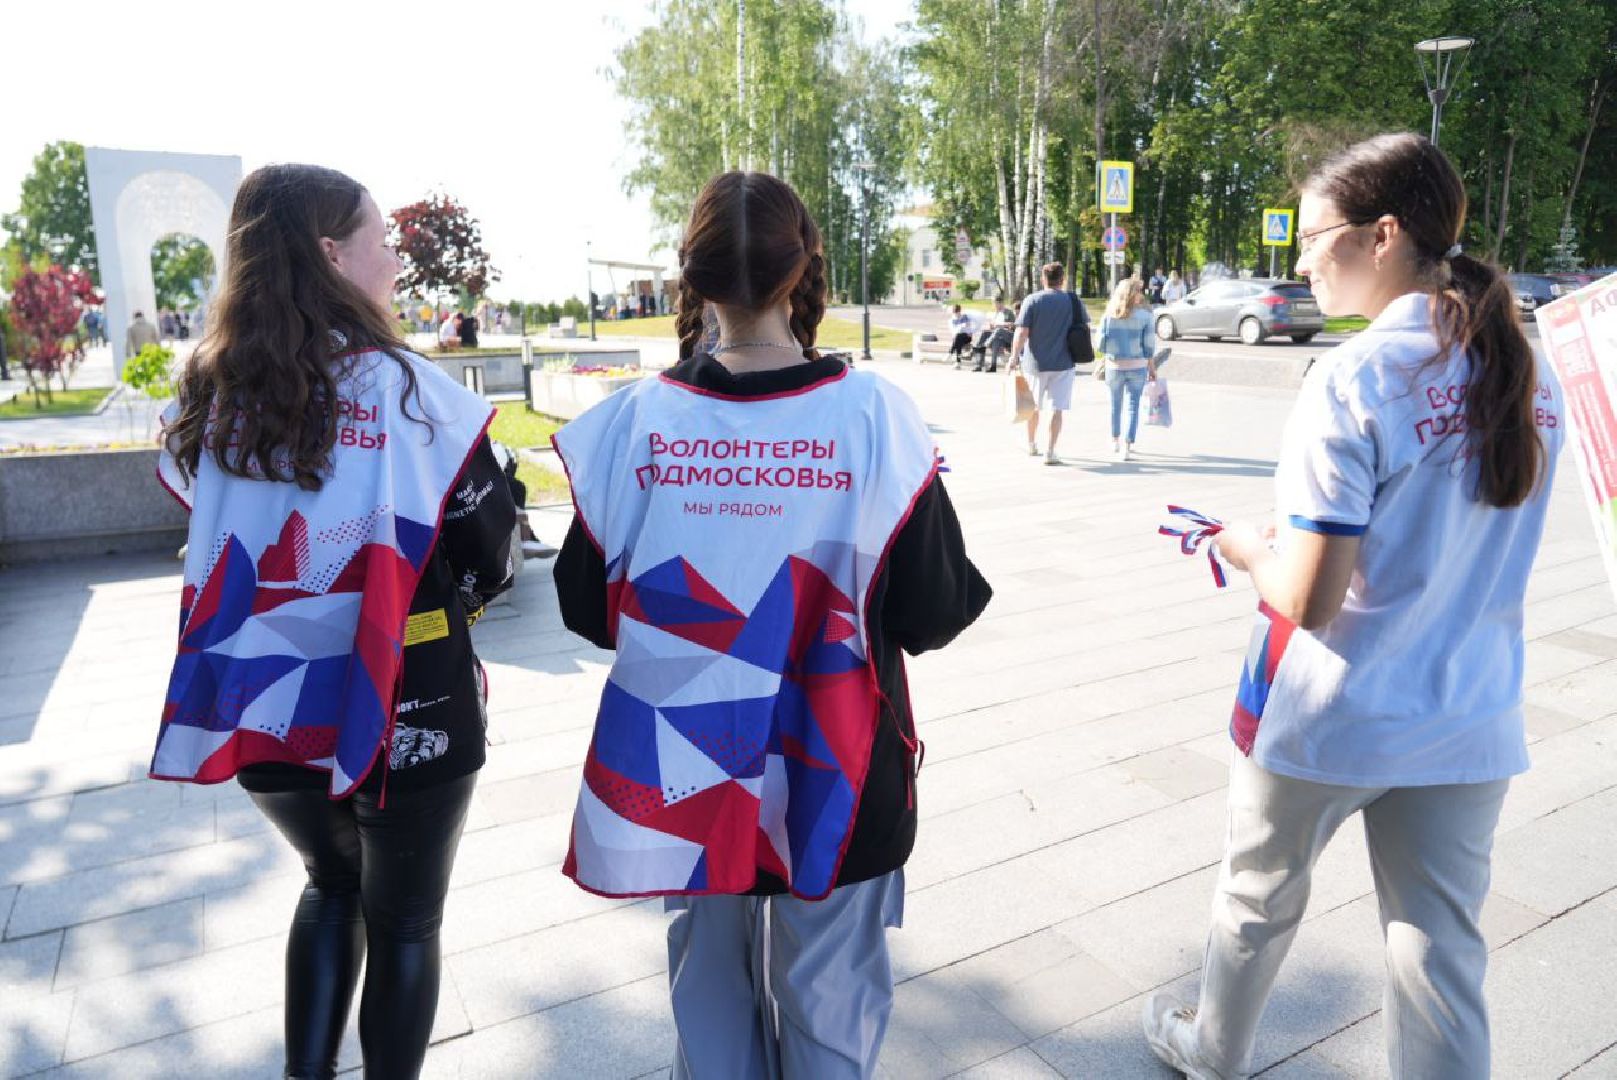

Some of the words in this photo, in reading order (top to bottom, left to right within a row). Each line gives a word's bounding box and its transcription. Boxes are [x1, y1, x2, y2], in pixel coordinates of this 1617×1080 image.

[649, 432, 835, 459] ВОЛОНТЕРЫ
[683, 501, 713, 516] МЫ
[719, 503, 784, 519] РЯДОМ
